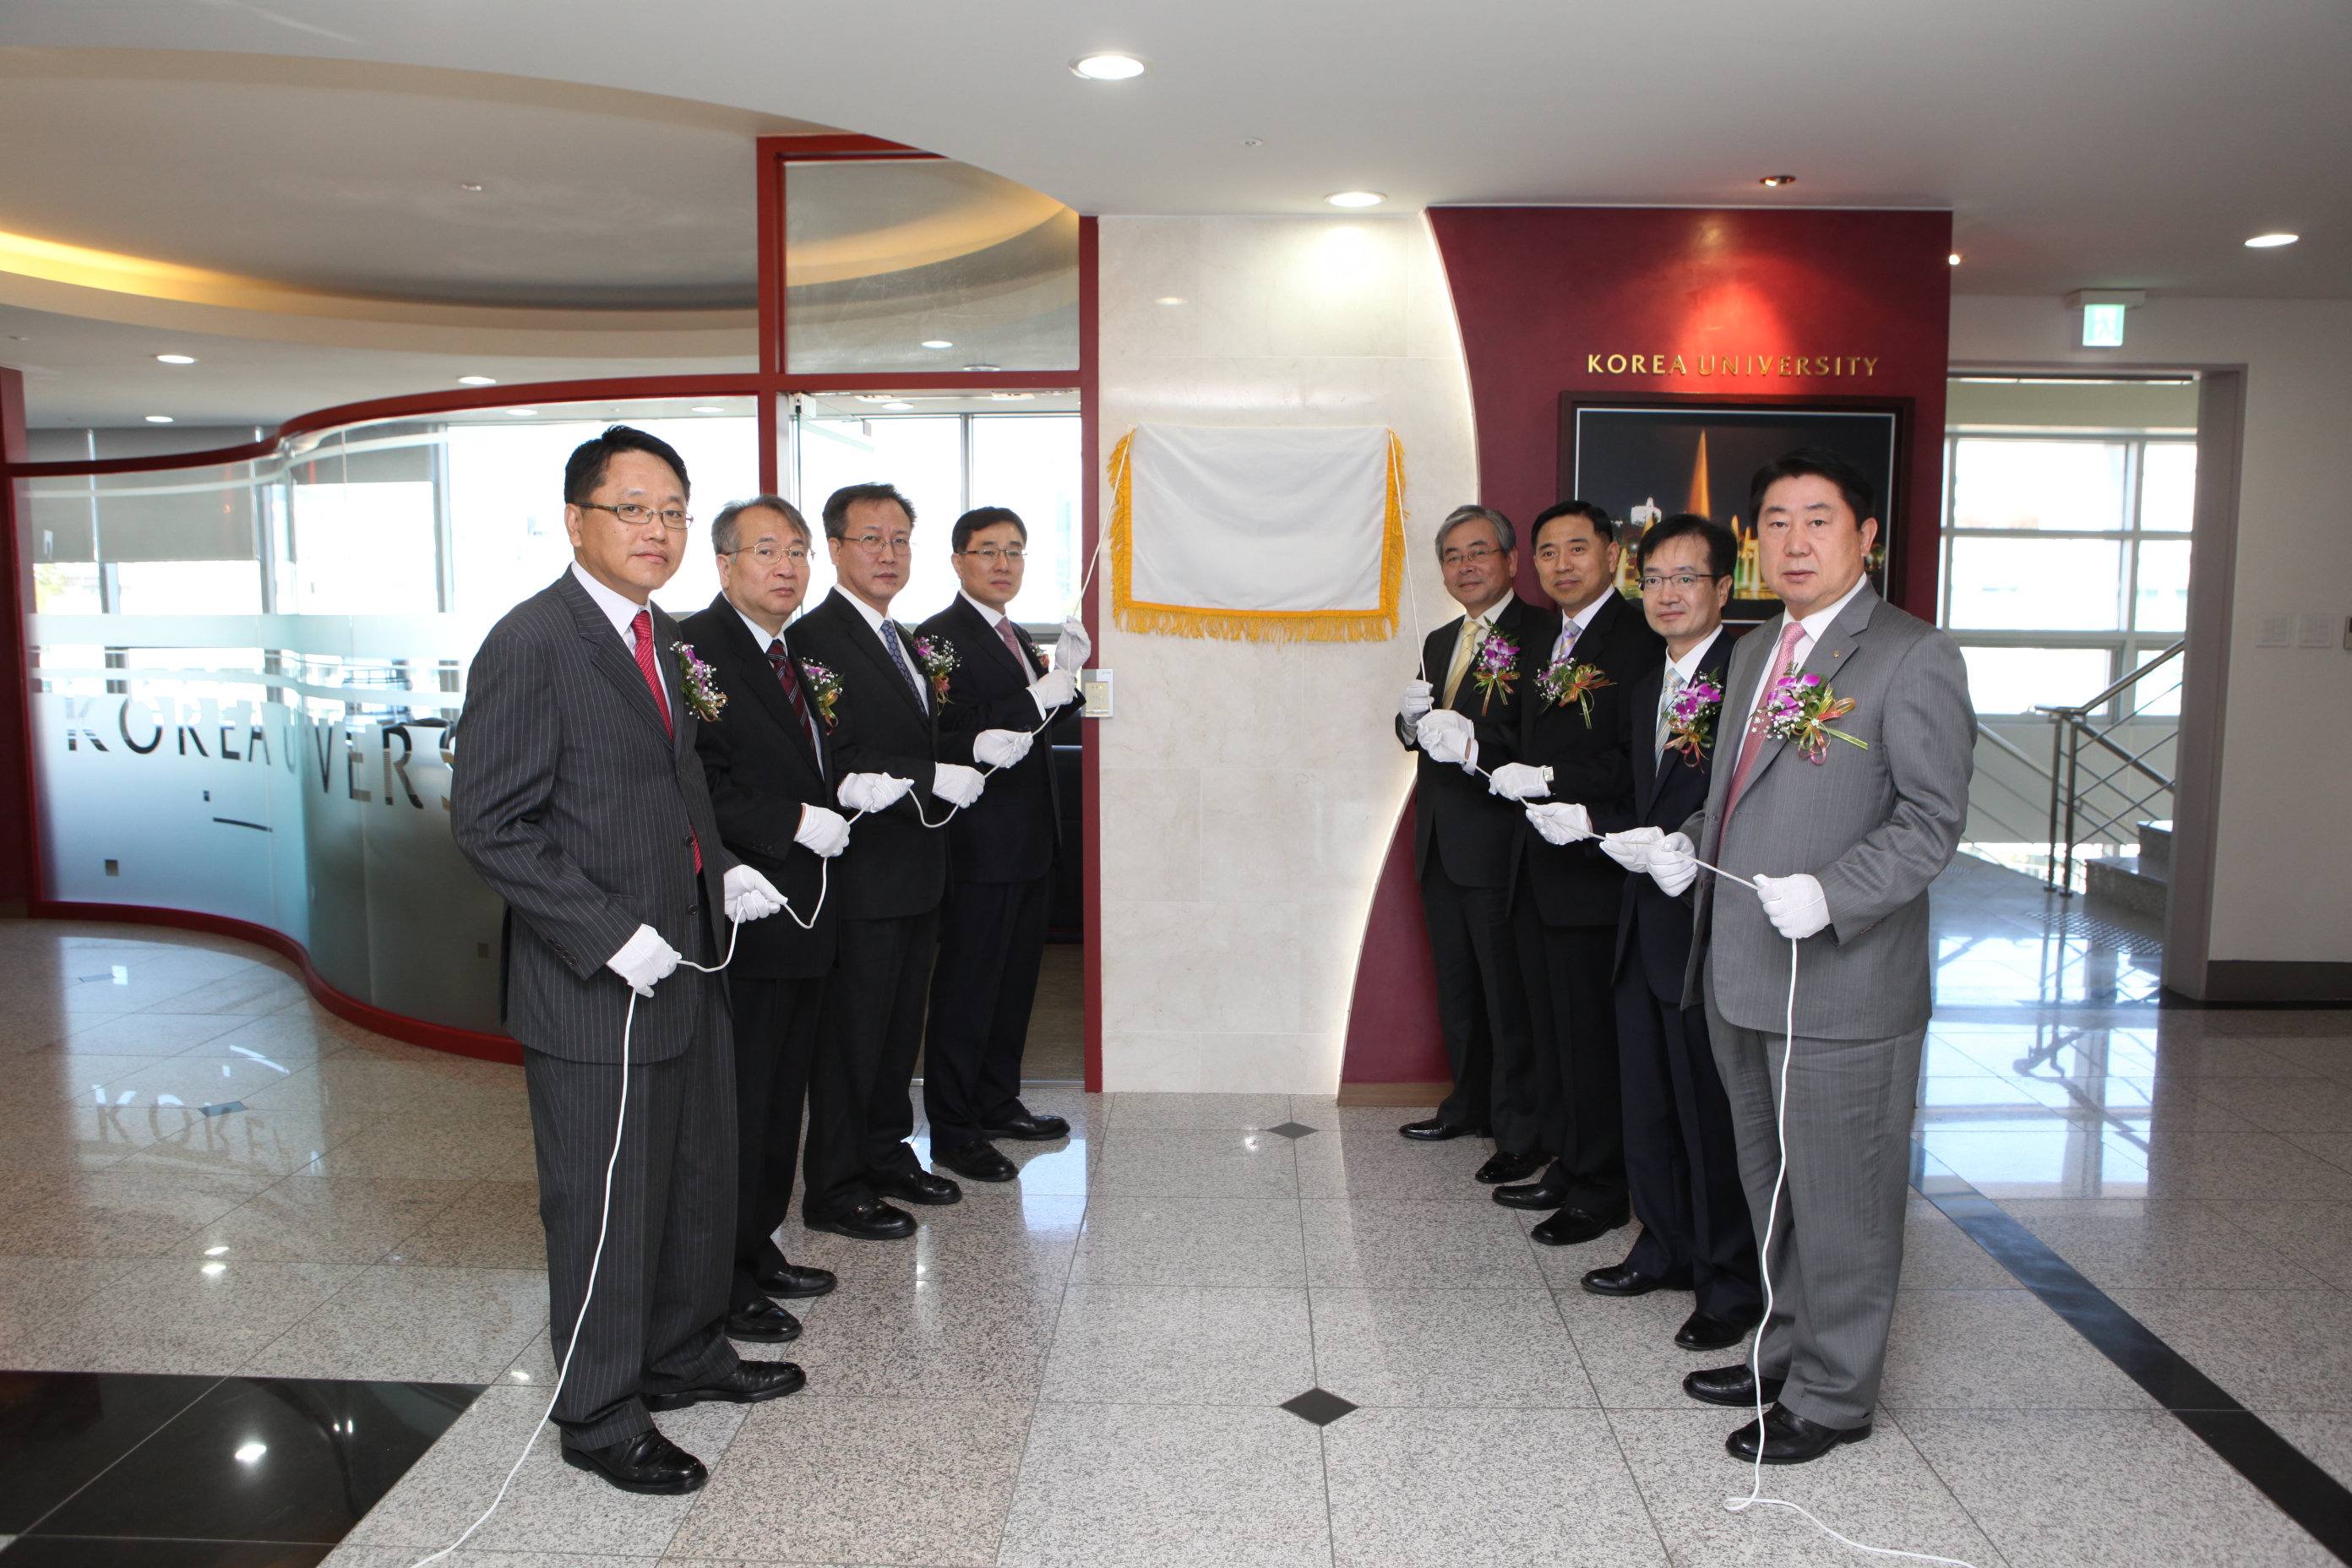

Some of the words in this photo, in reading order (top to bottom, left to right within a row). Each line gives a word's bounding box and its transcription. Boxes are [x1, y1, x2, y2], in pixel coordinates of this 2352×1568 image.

[1587, 353, 1686, 375] KOREA
[1697, 355, 1880, 377] UNIVERSITY
[65, 686, 272, 765] KOREA
